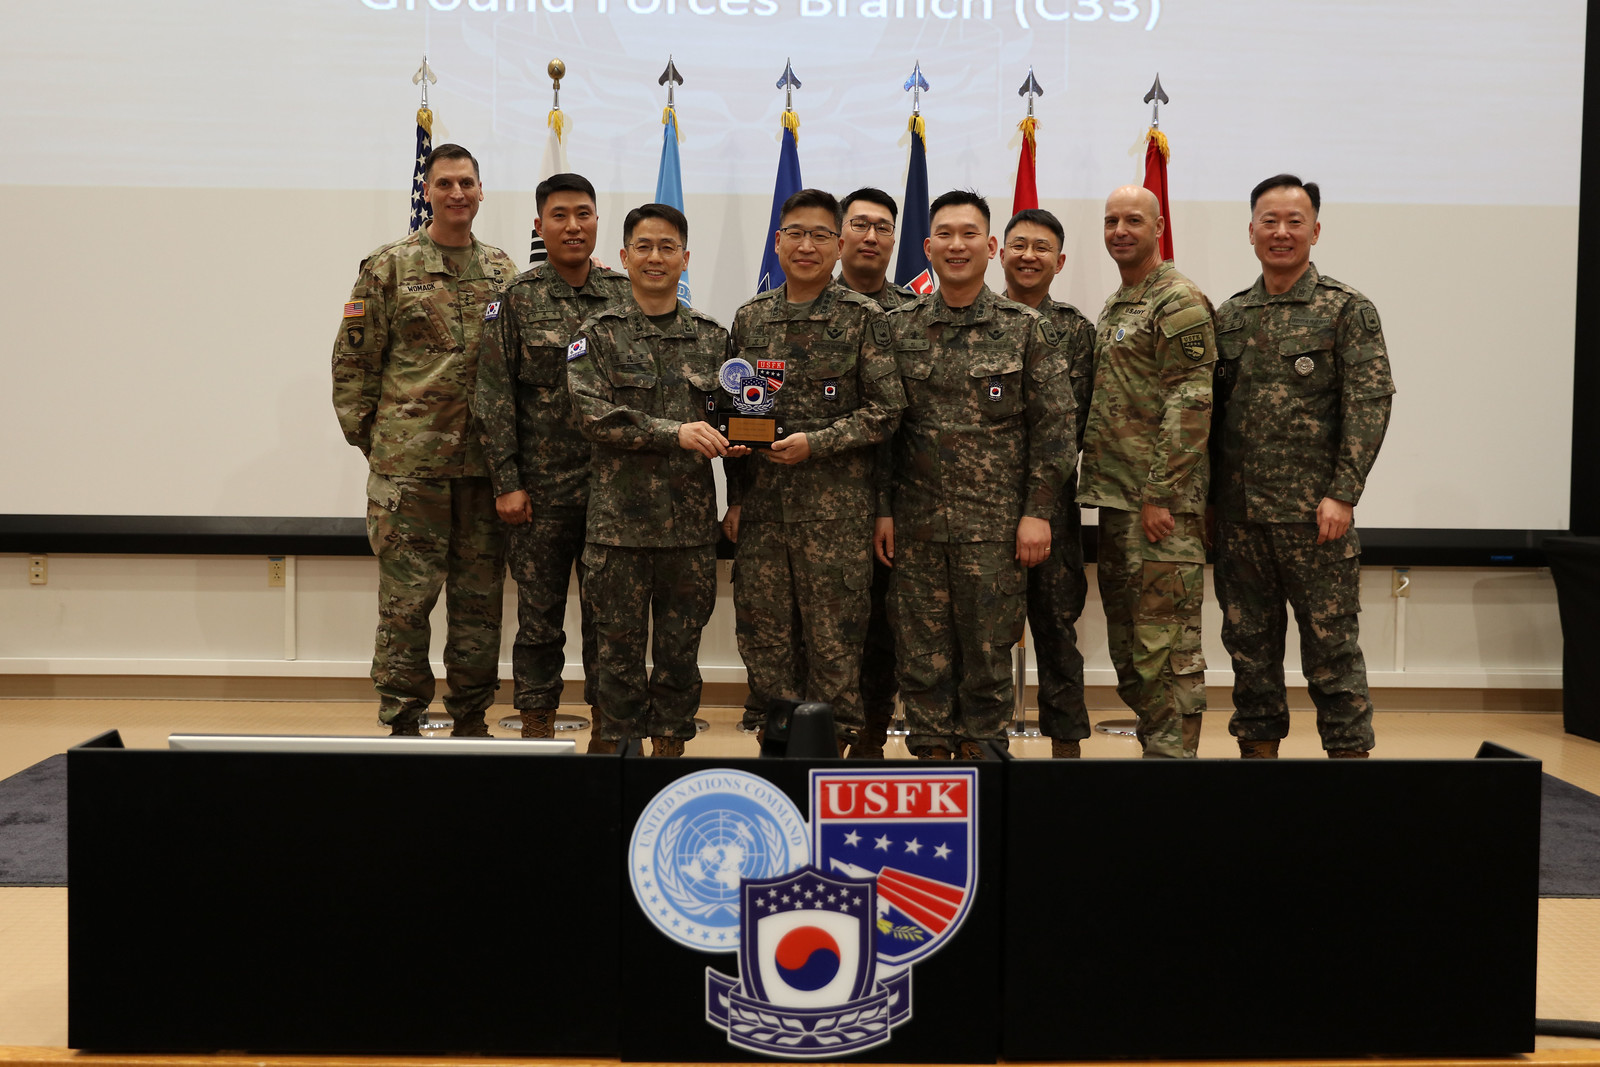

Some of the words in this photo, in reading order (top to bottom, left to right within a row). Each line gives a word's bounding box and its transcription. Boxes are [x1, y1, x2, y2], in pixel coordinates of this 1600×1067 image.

[1014, 0, 1161, 31] (C33)
[407, 282, 436, 292] WOMACK
[760, 361, 782, 369] USFK
[639, 797, 676, 848] UNITED
[675, 777, 742, 798] NATIONS
[744, 780, 803, 847] COMMAND
[825, 781, 963, 816] USFK
